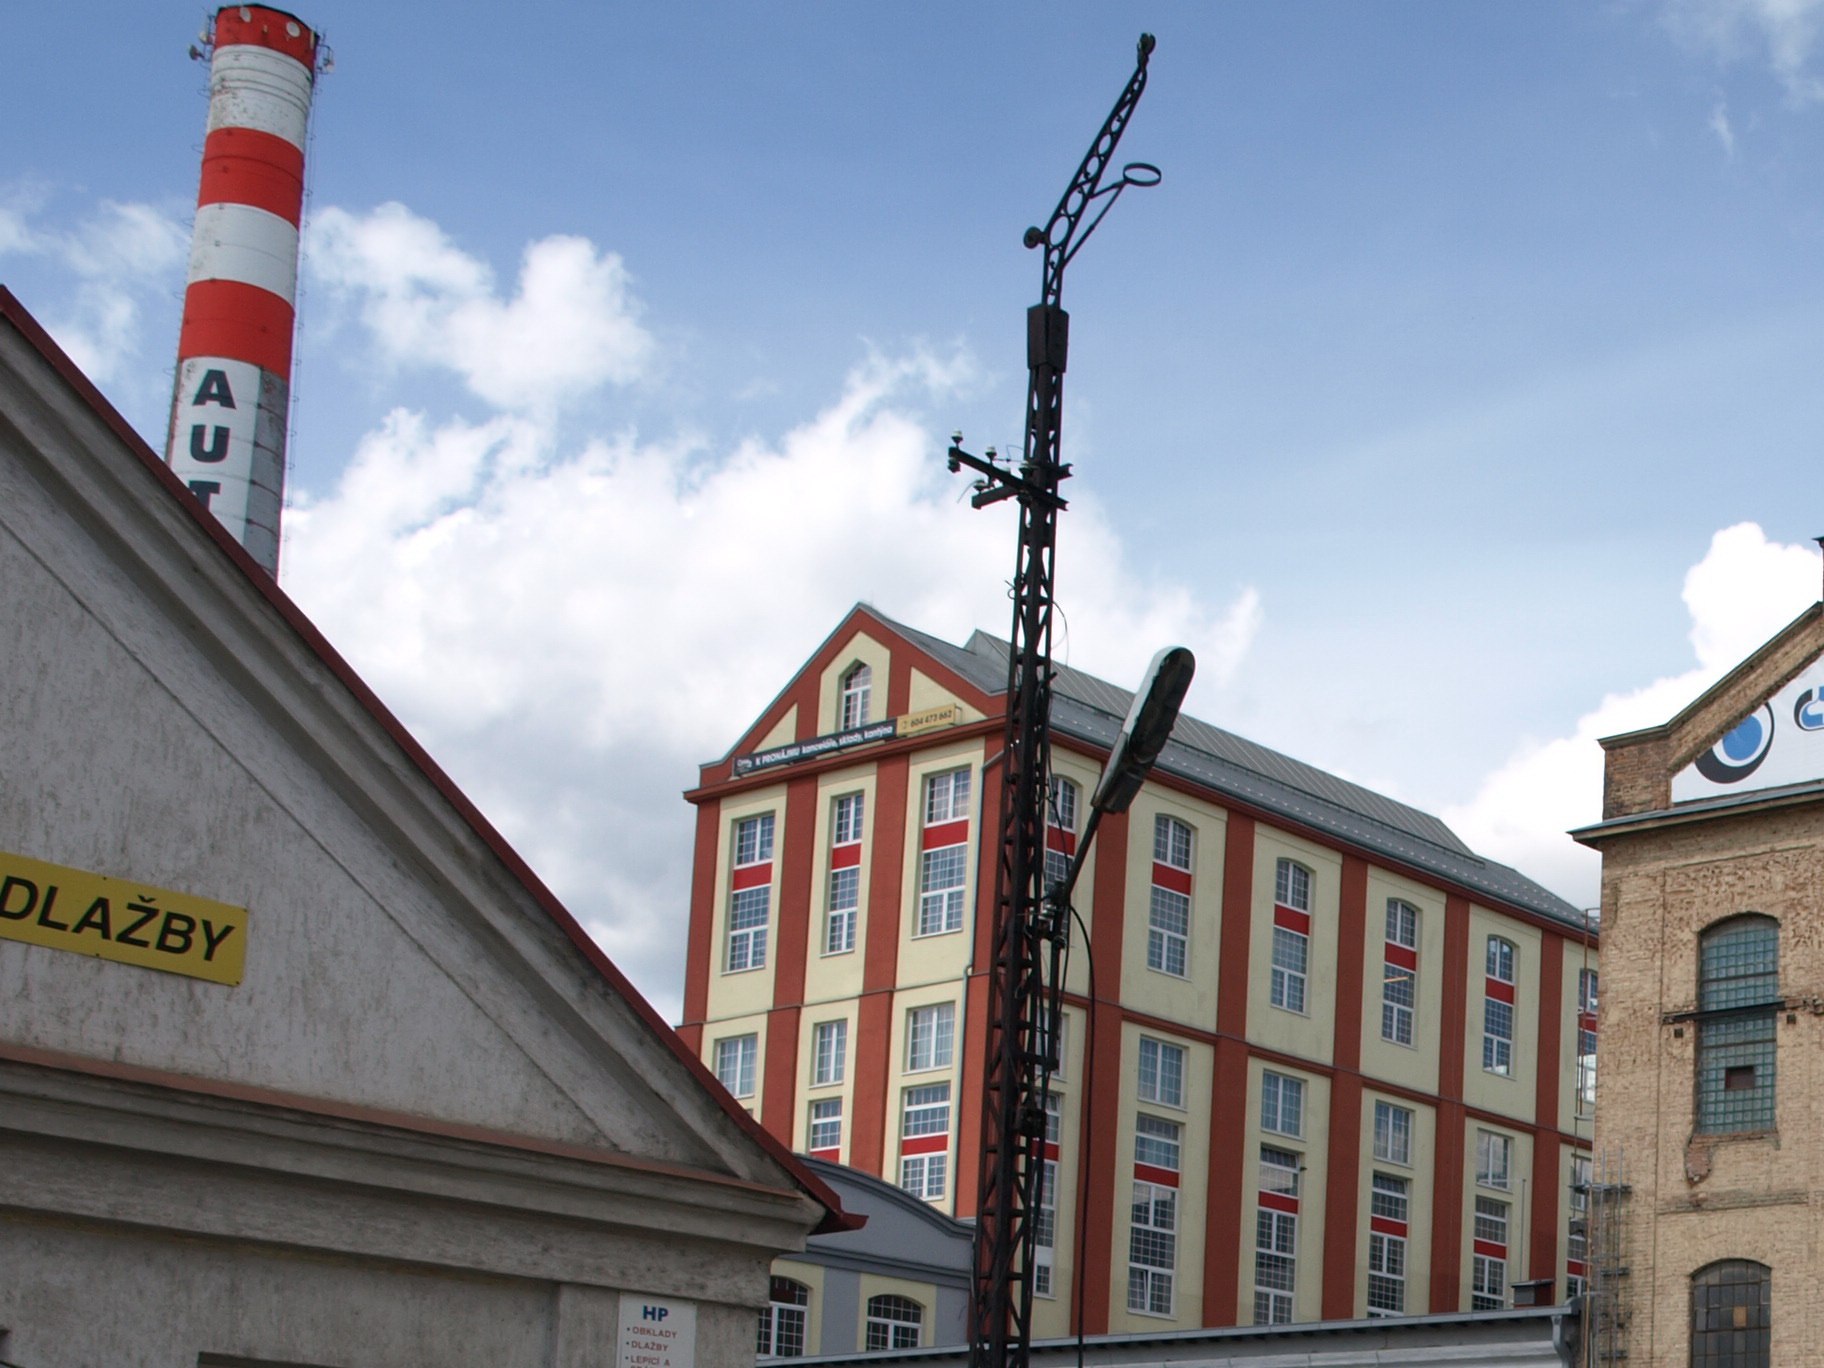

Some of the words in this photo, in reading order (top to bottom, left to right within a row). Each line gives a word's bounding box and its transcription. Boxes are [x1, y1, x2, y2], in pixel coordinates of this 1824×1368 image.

[0, 874, 236, 962] DLAŽBY
[642, 1305, 669, 1322] HP
[632, 1326, 678, 1339] OBKLADY
[631, 1340, 669, 1352] DLAŽBY
[664, 1358, 670, 1367] A
